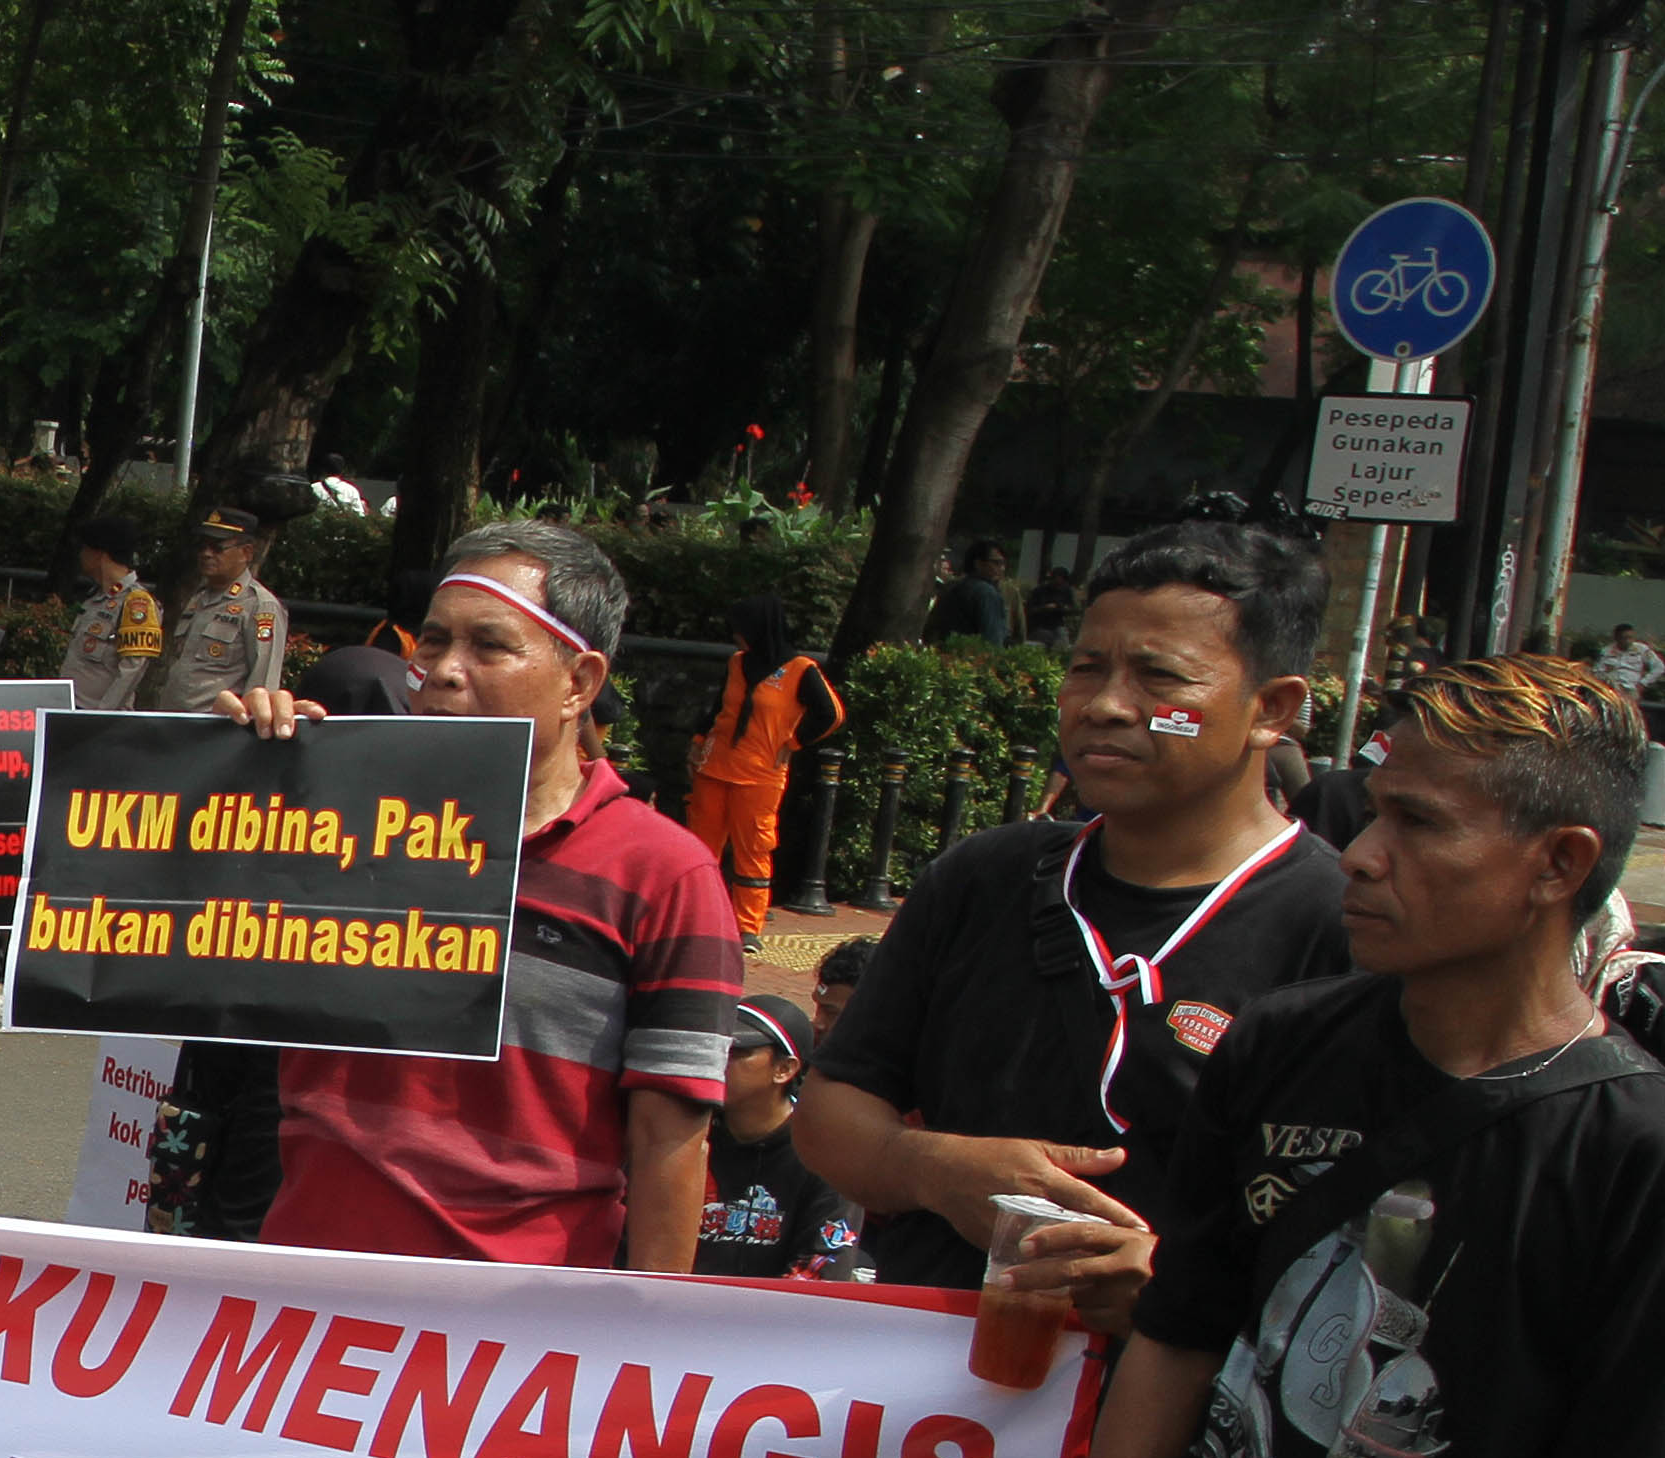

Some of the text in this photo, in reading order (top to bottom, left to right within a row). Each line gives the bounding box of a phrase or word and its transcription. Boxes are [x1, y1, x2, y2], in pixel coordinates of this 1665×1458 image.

[1329, 409, 1454, 431] Pesepeda
[1332, 434, 1444, 456] Gunakan
[1351, 462, 1416, 483] Lajur
[1332, 486, 1439, 508] Seped
[64, 790, 487, 877] UKM dibina, Pak,
[27, 891, 501, 976] bukan dibinasakan
[102, 1056, 174, 1102] Retribu
[109, 1111, 142, 1148] kok
[125, 1177, 150, 1205] pe
